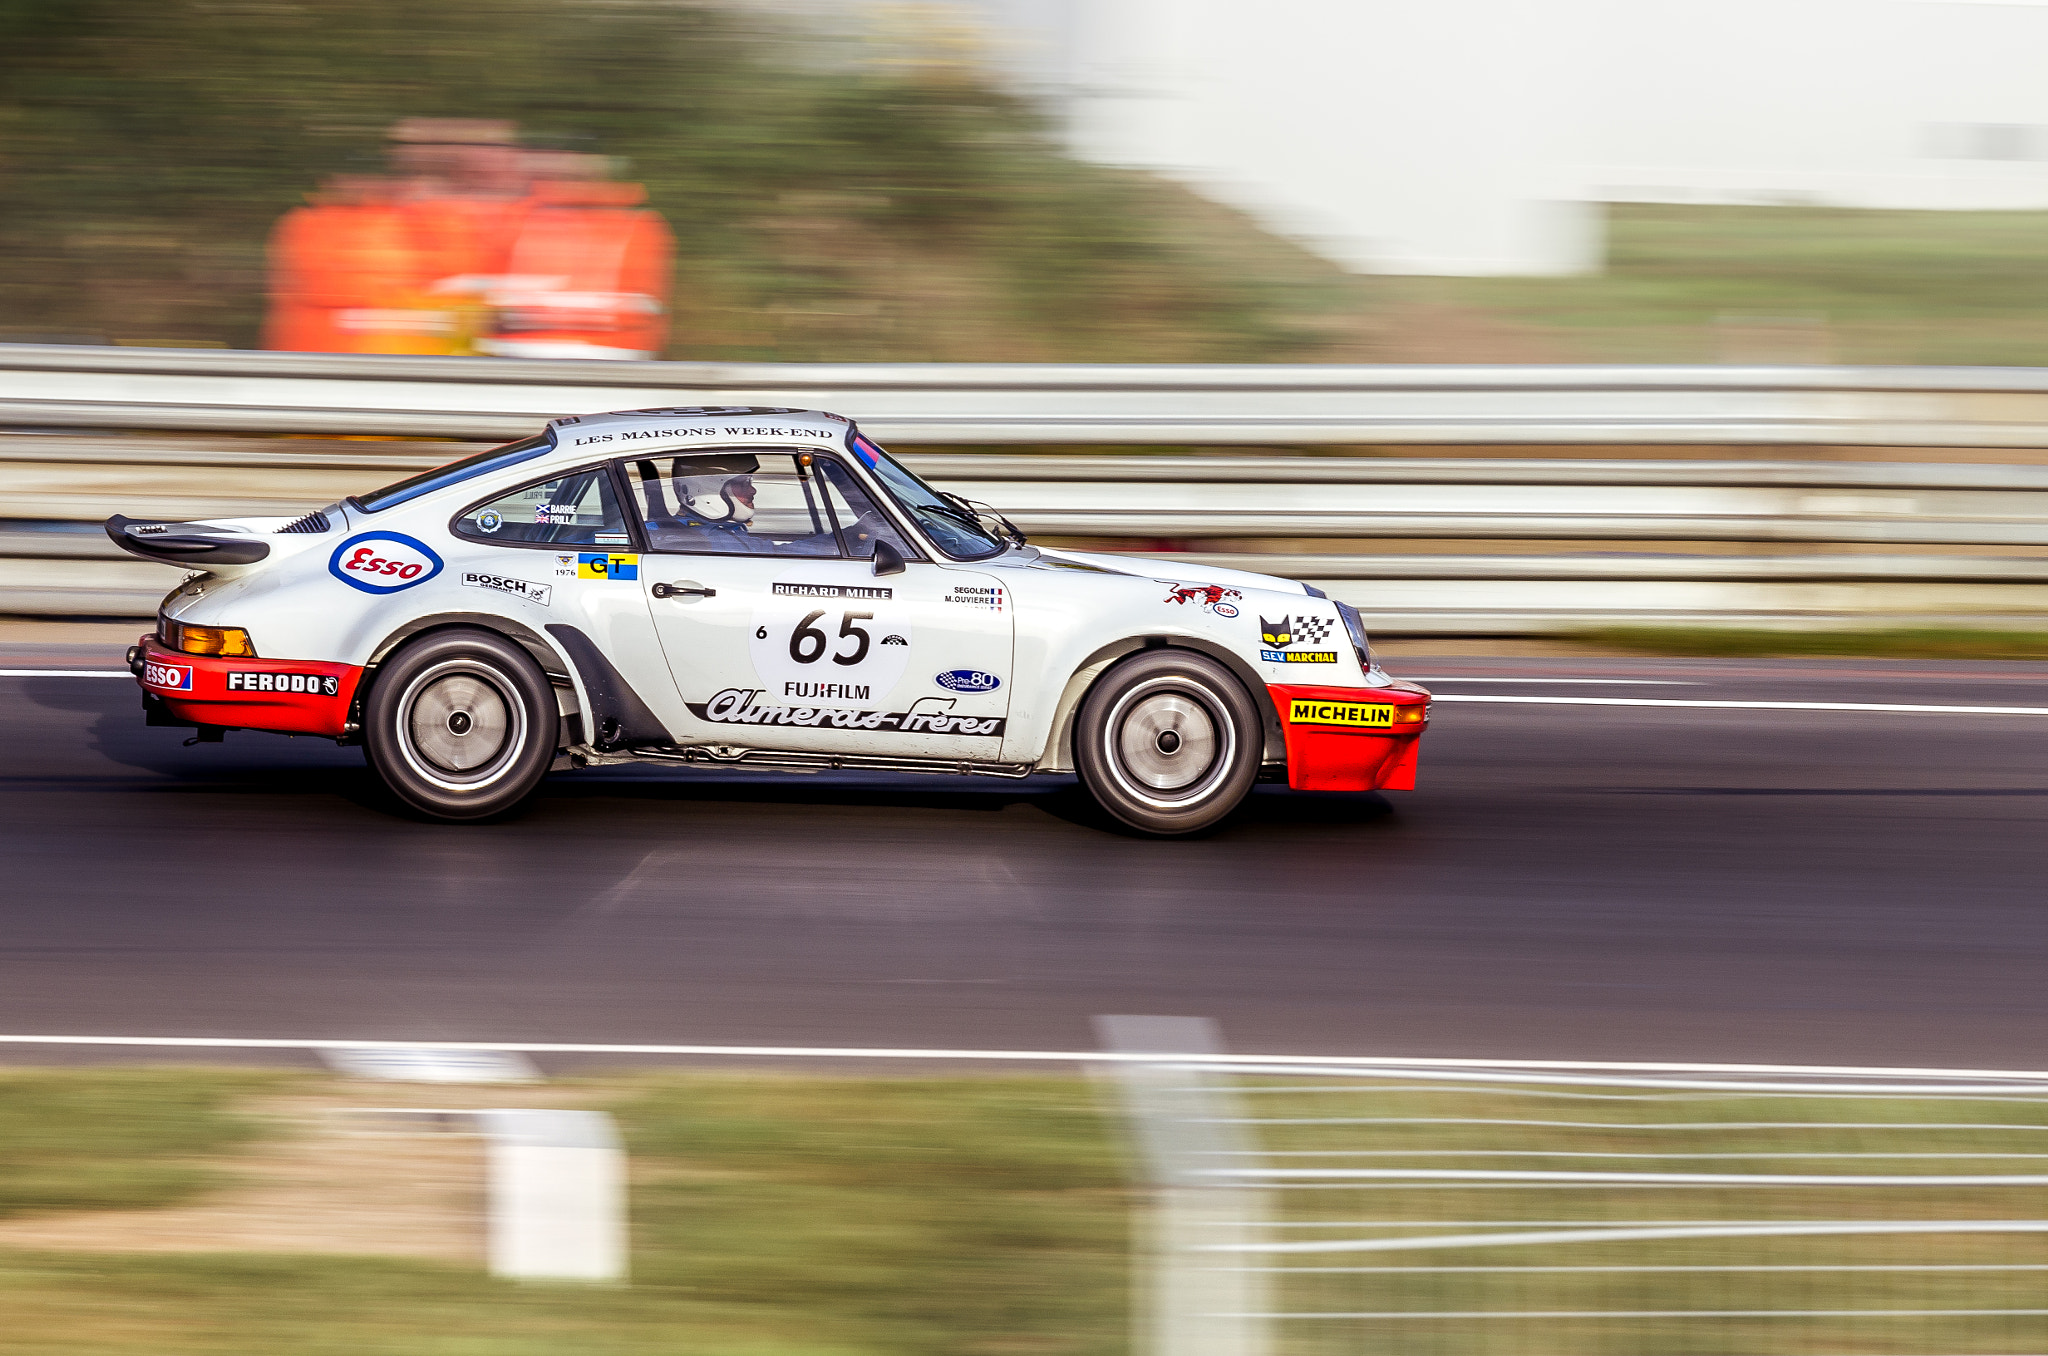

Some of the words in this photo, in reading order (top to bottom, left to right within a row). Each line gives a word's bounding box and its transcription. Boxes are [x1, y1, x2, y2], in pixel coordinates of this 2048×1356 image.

[574, 434, 613, 446] LES
[621, 427, 716, 441] MAISONS
[724, 427, 834, 439] WEEK-END
[550, 504, 577, 514] BARRIE
[550, 515, 571, 525] PRILL
[555, 569, 576, 577] 1976
[589, 557, 626, 574] GT
[466, 573, 527, 593] BOSCH
[775, 584, 839, 597] RICHARD
[845, 586, 890, 599] MILLE
[954, 586, 990, 595] SEGOLEN
[755, 625, 768, 640] 6
[789, 608, 875, 666] 65
[1286, 652, 1336, 663] MARCHAL
[146, 664, 181, 686] ESSO
[229, 673, 320, 693] FERODO
[784, 681, 870, 700] FUJIFILM
[1294, 705, 1390, 723] MICHELIN
